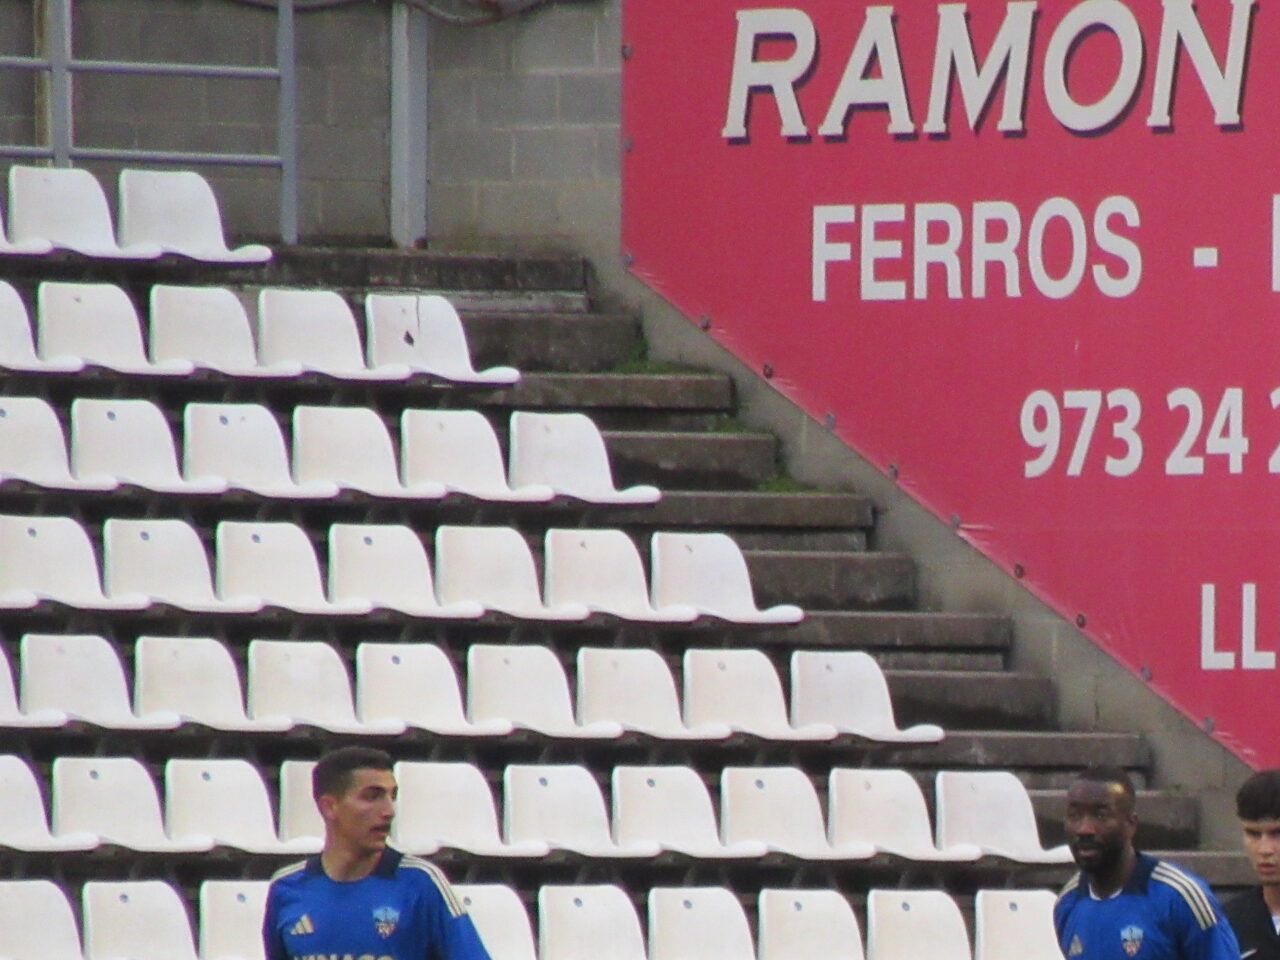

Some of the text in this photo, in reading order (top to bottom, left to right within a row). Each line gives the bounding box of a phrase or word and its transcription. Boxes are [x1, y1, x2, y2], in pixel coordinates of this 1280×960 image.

[721, 0, 1256, 140] RAMON
[811, 196, 1143, 301] FERROS
[1020, 388, 1143, 478] 973
[1165, 386, 1249, 475] 24
